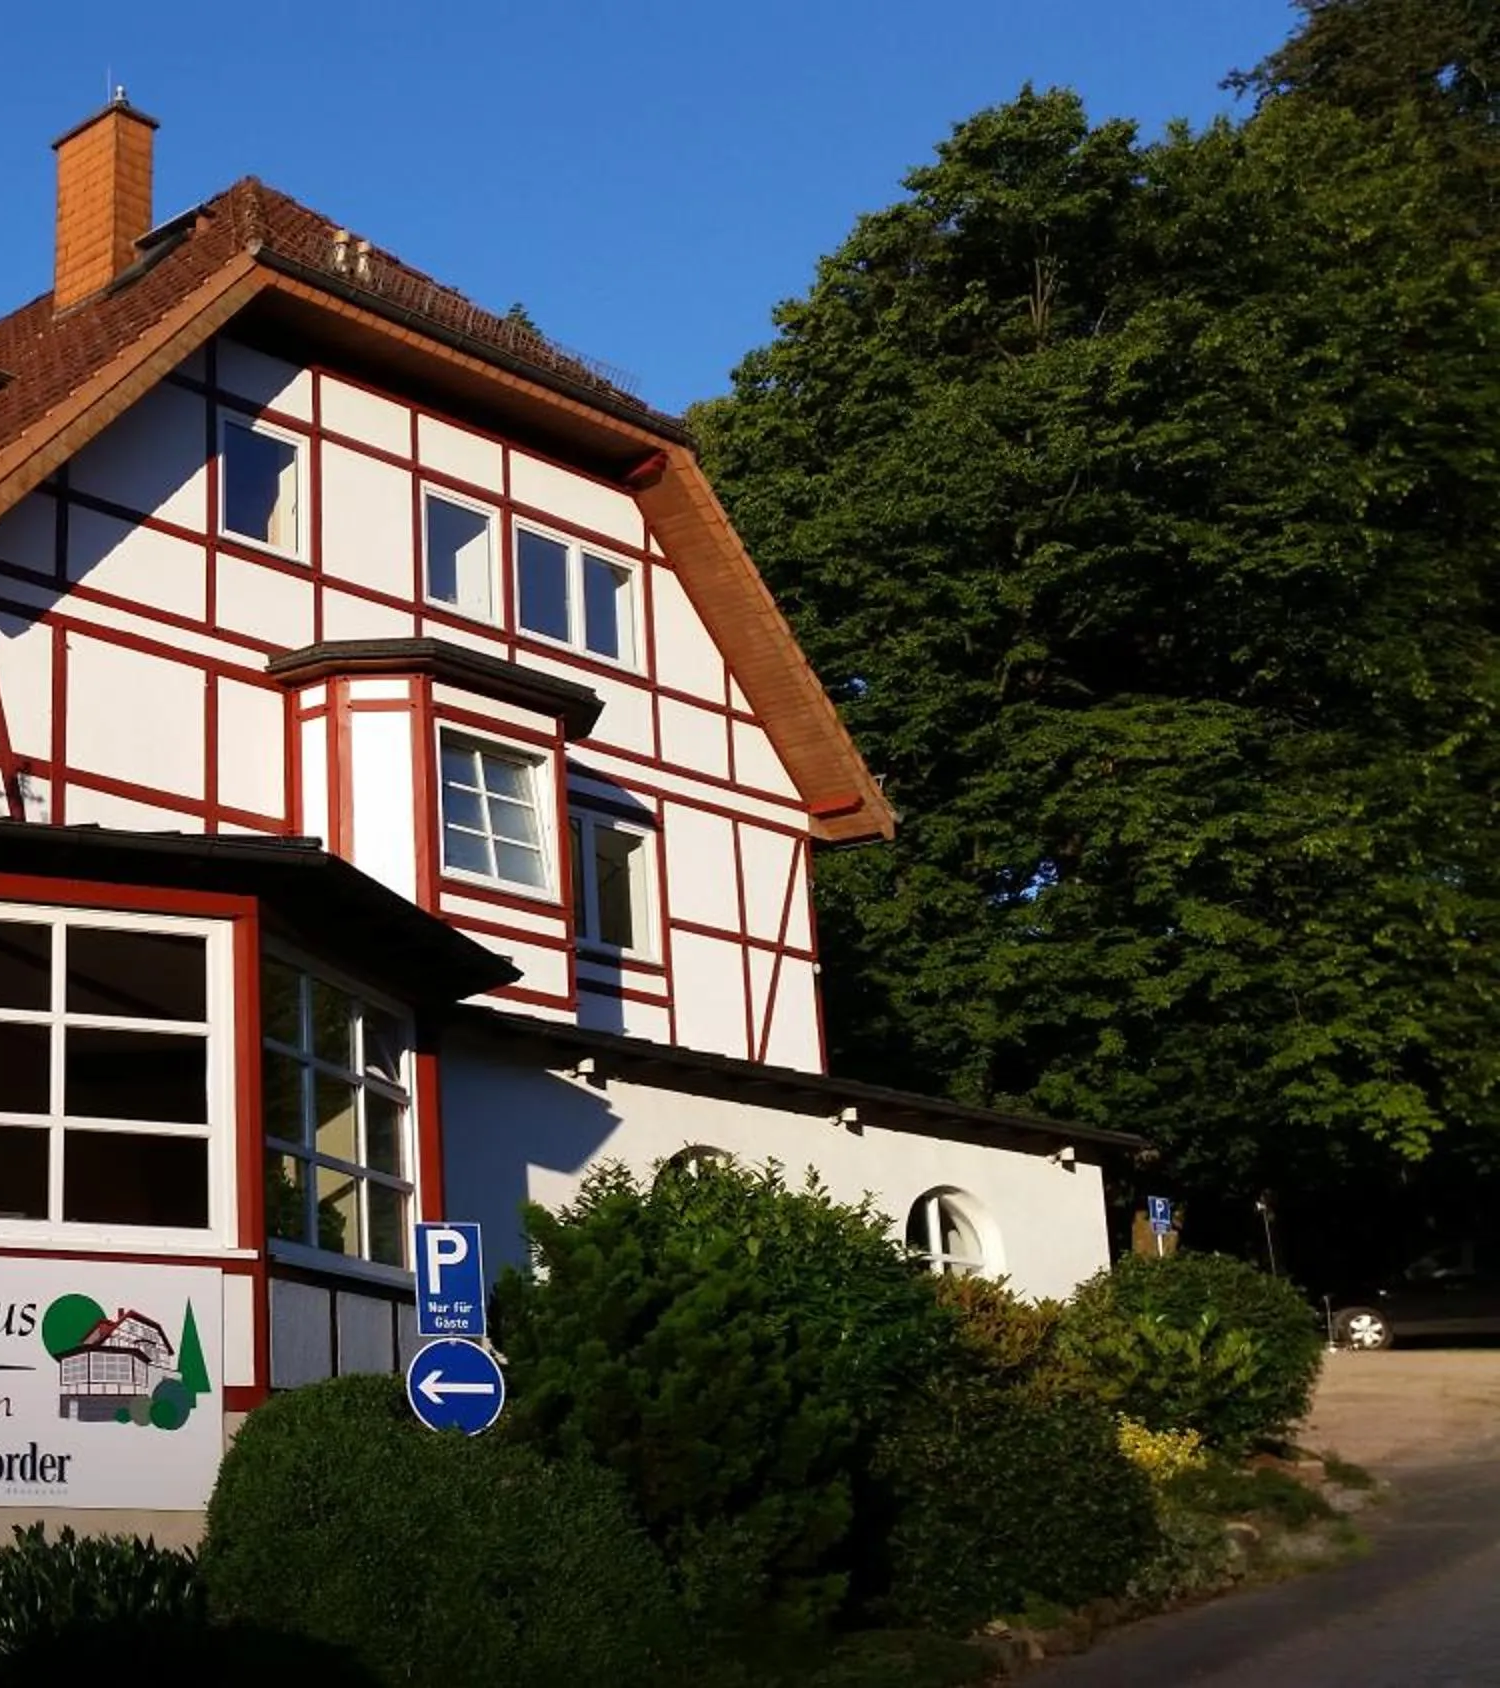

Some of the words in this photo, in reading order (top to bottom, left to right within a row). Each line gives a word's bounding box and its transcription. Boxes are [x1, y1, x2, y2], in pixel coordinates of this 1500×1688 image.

[1156, 1200, 1165, 1219] P
[426, 1229, 468, 1294] P
[428, 1301, 450, 1313] Nur
[453, 1301, 473, 1313] für
[434, 1315, 469, 1329] Gäste
